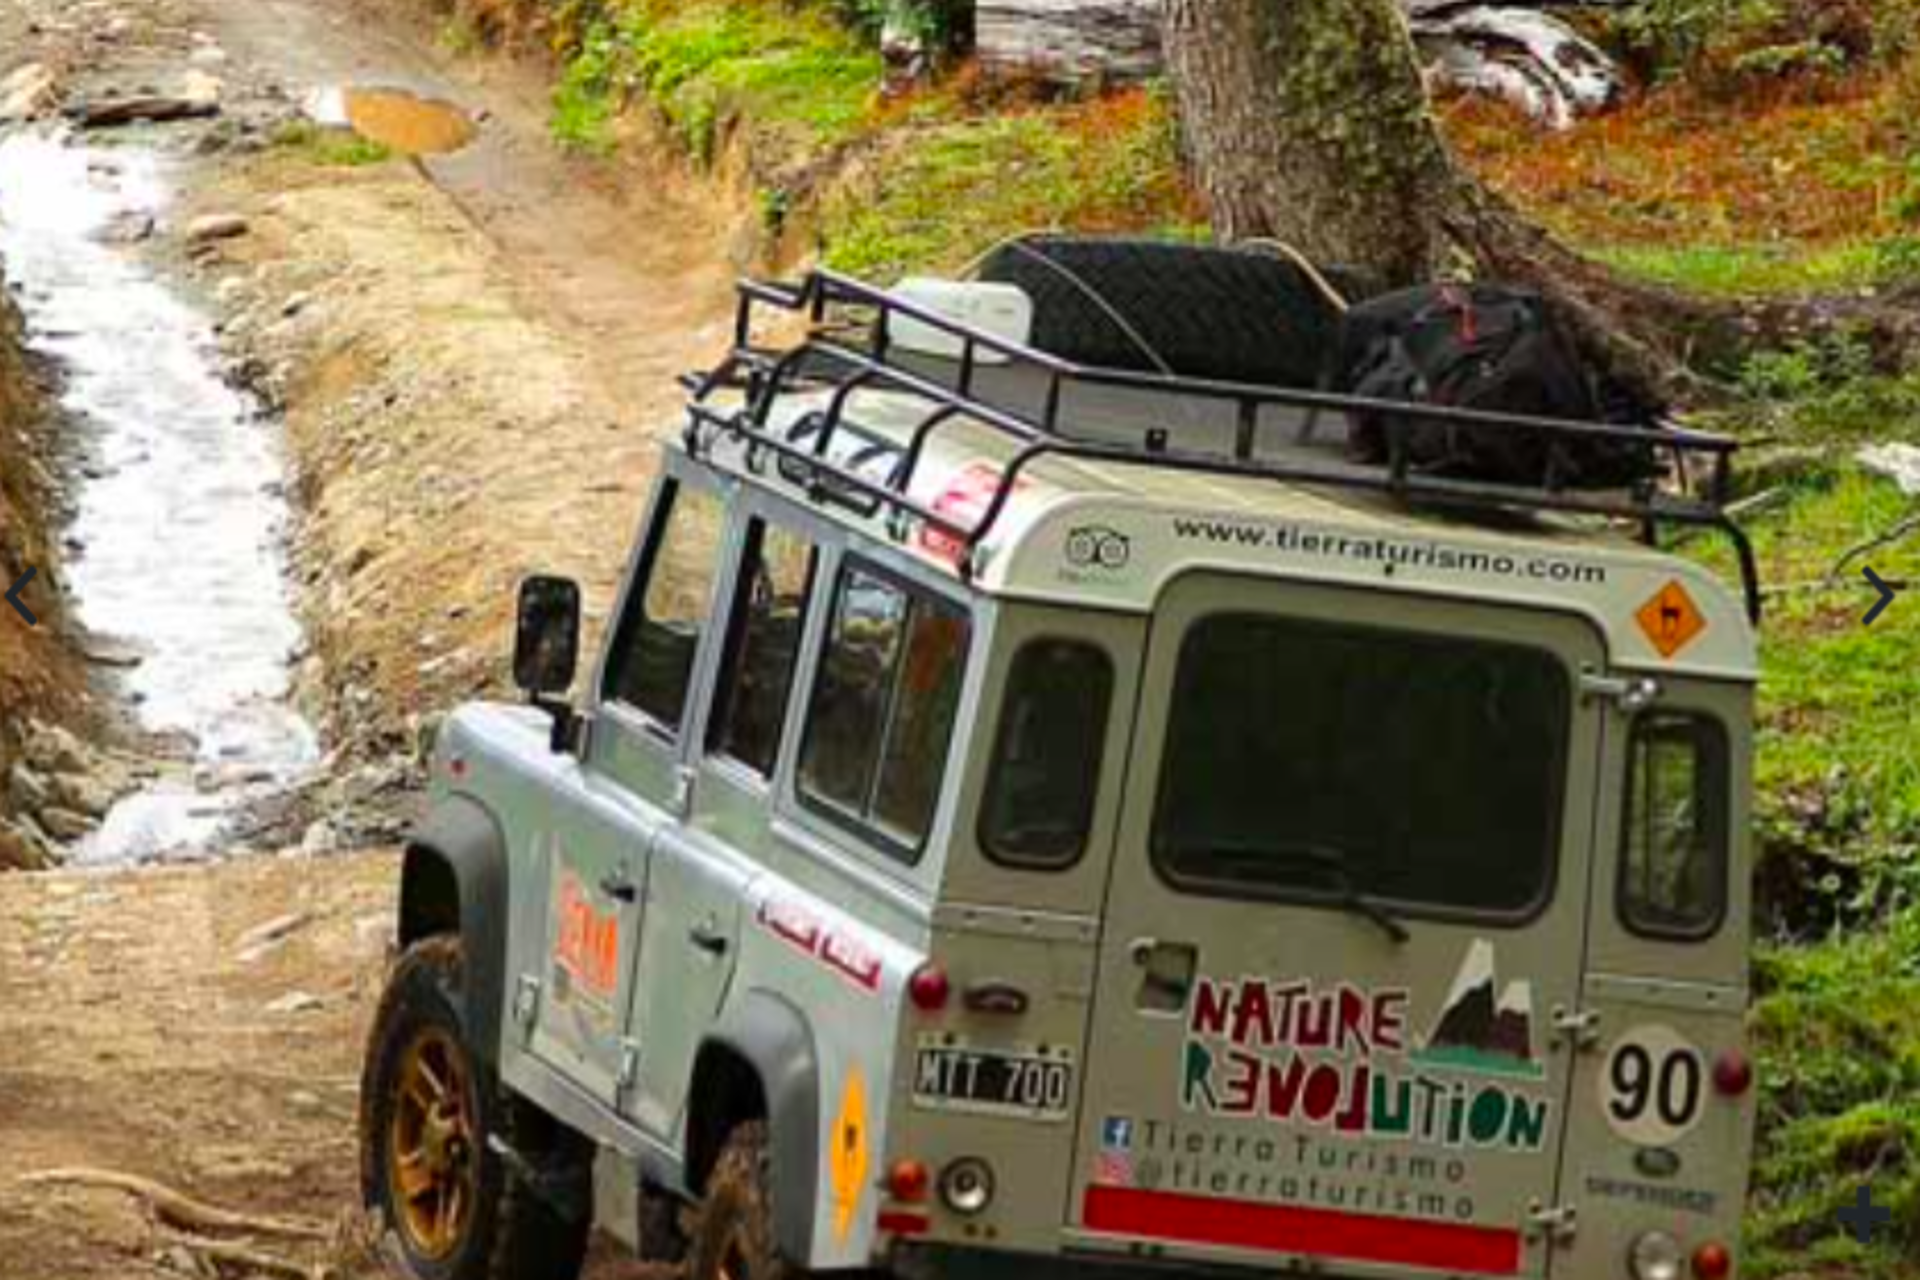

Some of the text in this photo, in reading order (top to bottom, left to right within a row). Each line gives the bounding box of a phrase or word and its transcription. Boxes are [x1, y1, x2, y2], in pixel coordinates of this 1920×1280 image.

[1173, 516, 1606, 584] www.tierraturismo.com
[1192, 981, 1407, 1054] NATURE
[1004, 1061, 1065, 1108] 700
[1185, 1042, 1546, 1147] REVOLUTION
[1610, 1043, 1700, 1126] 90
[1144, 1120, 1465, 1183] Tierra Turismo
[1136, 1157, 1474, 1220] @tierraturismo
